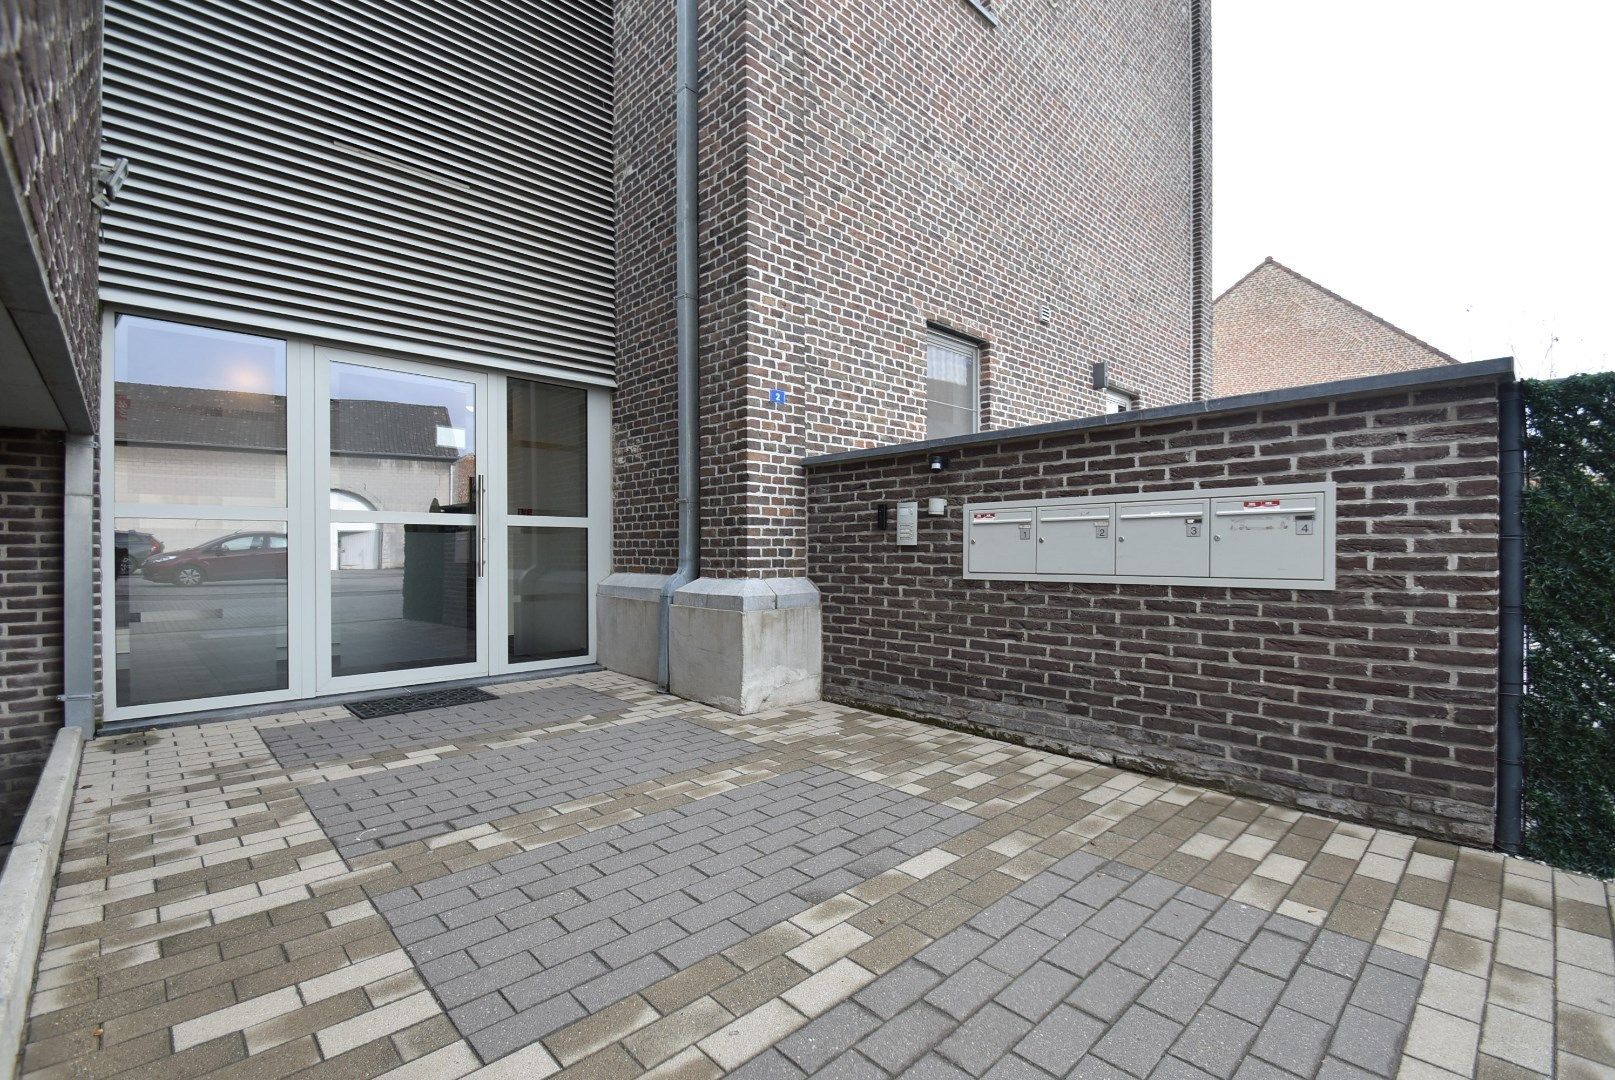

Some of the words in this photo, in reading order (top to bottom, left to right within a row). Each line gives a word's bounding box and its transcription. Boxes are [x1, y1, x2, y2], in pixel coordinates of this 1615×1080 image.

[775, 392, 780, 400] 2
[1190, 526, 1197, 535] 3
[1301, 524, 1309, 533] 4
